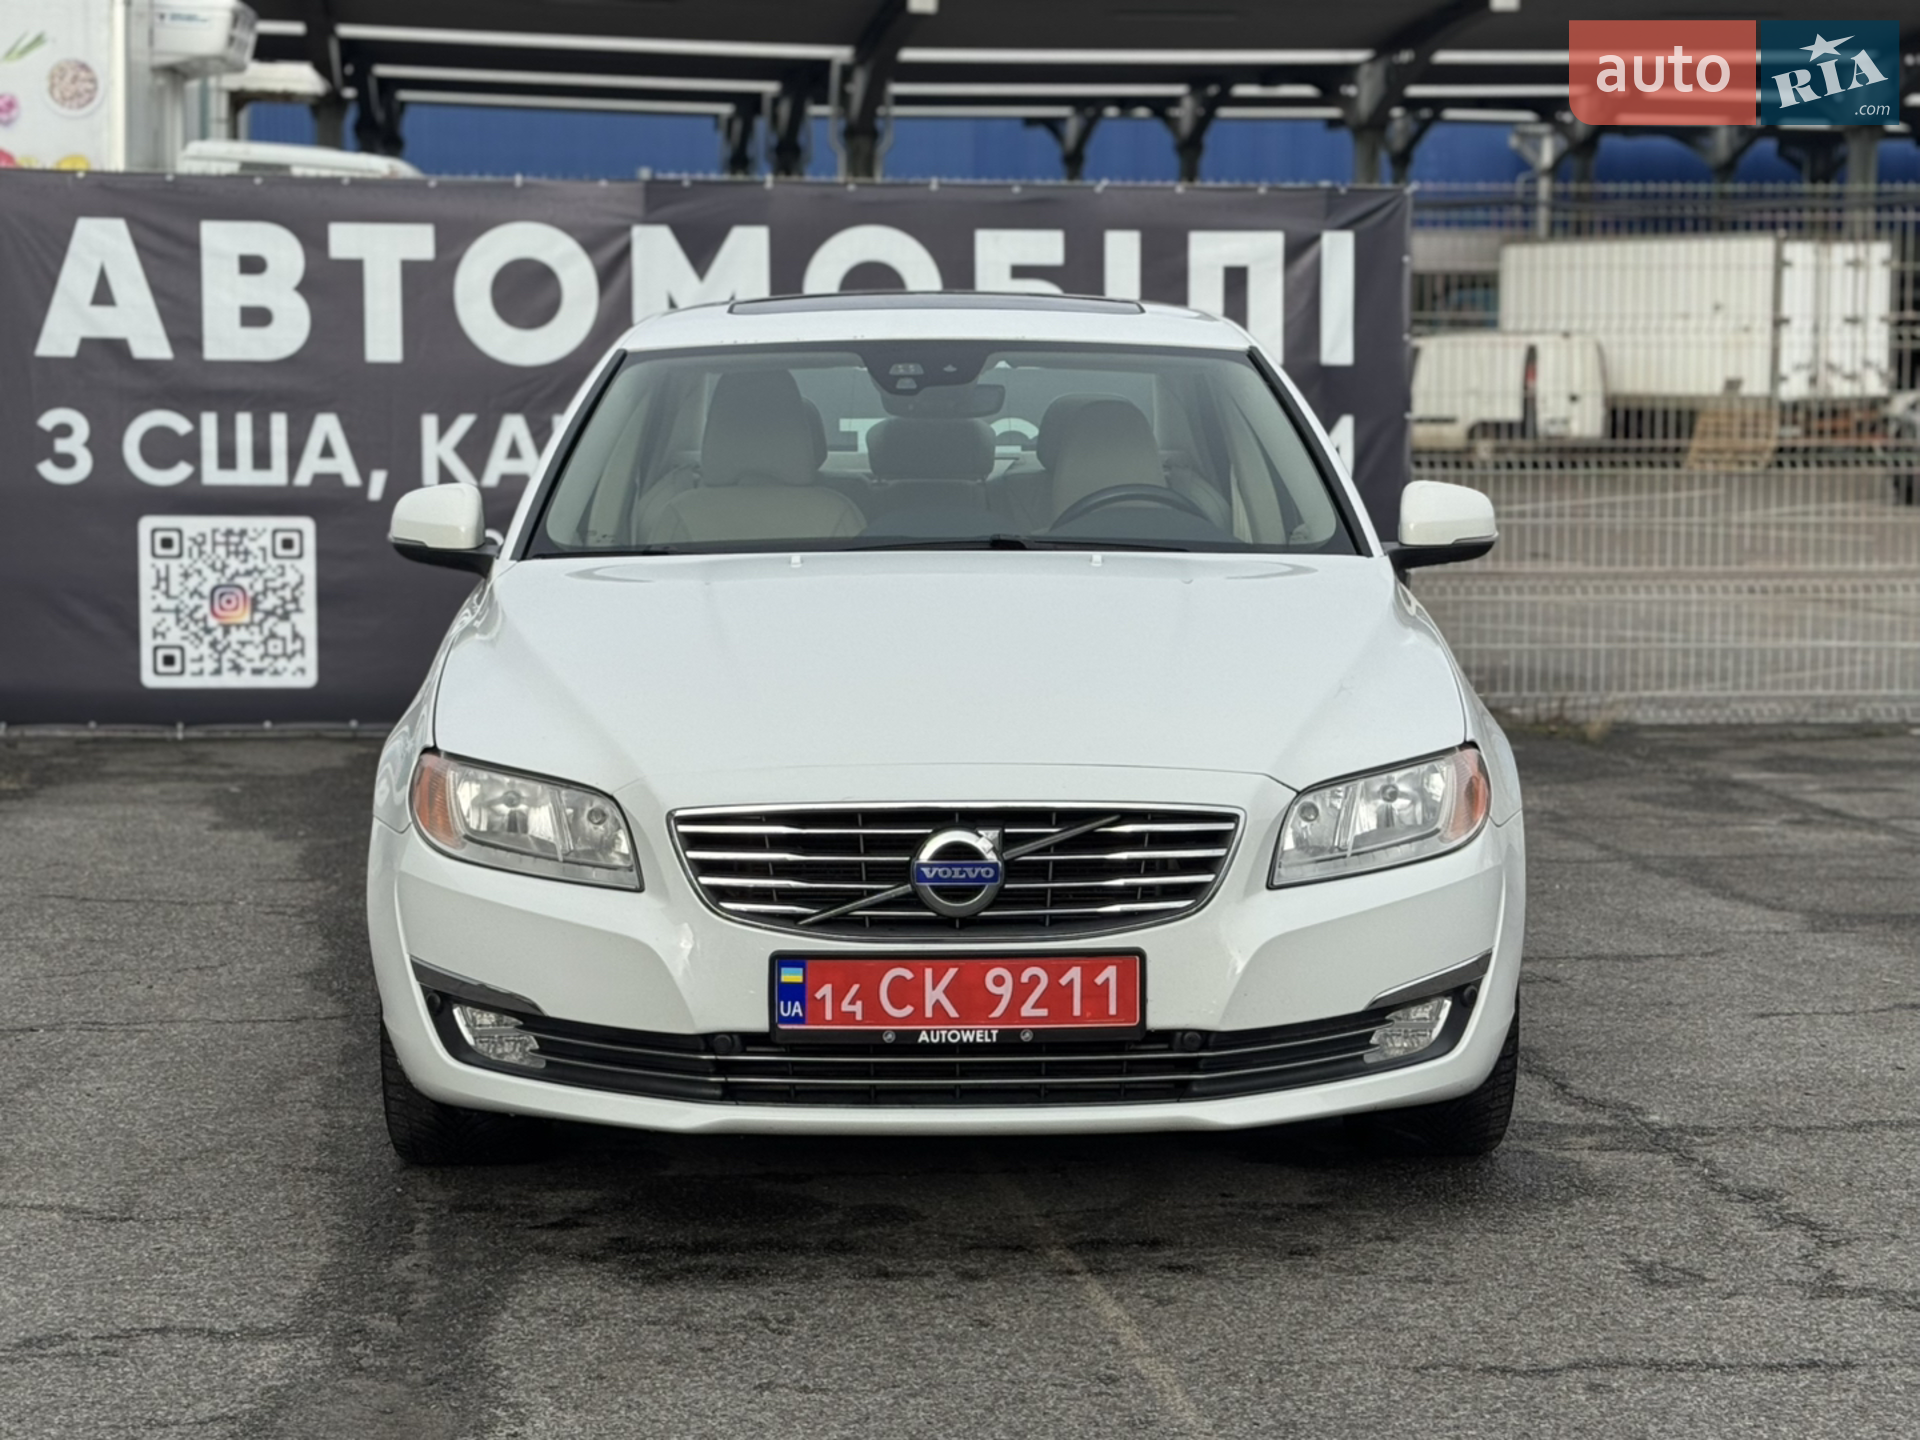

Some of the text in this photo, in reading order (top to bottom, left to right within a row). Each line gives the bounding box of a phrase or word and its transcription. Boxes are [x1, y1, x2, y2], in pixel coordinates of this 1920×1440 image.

[36, 408, 93, 484] З
[122, 410, 388, 501] США,
[920, 866, 995, 879] VOLVO
[814, 983, 863, 1021] 14
[984, 965, 1118, 1018] 9211
[780, 1001, 803, 1017] UA
[917, 1029, 999, 1043] AUTOWELT
